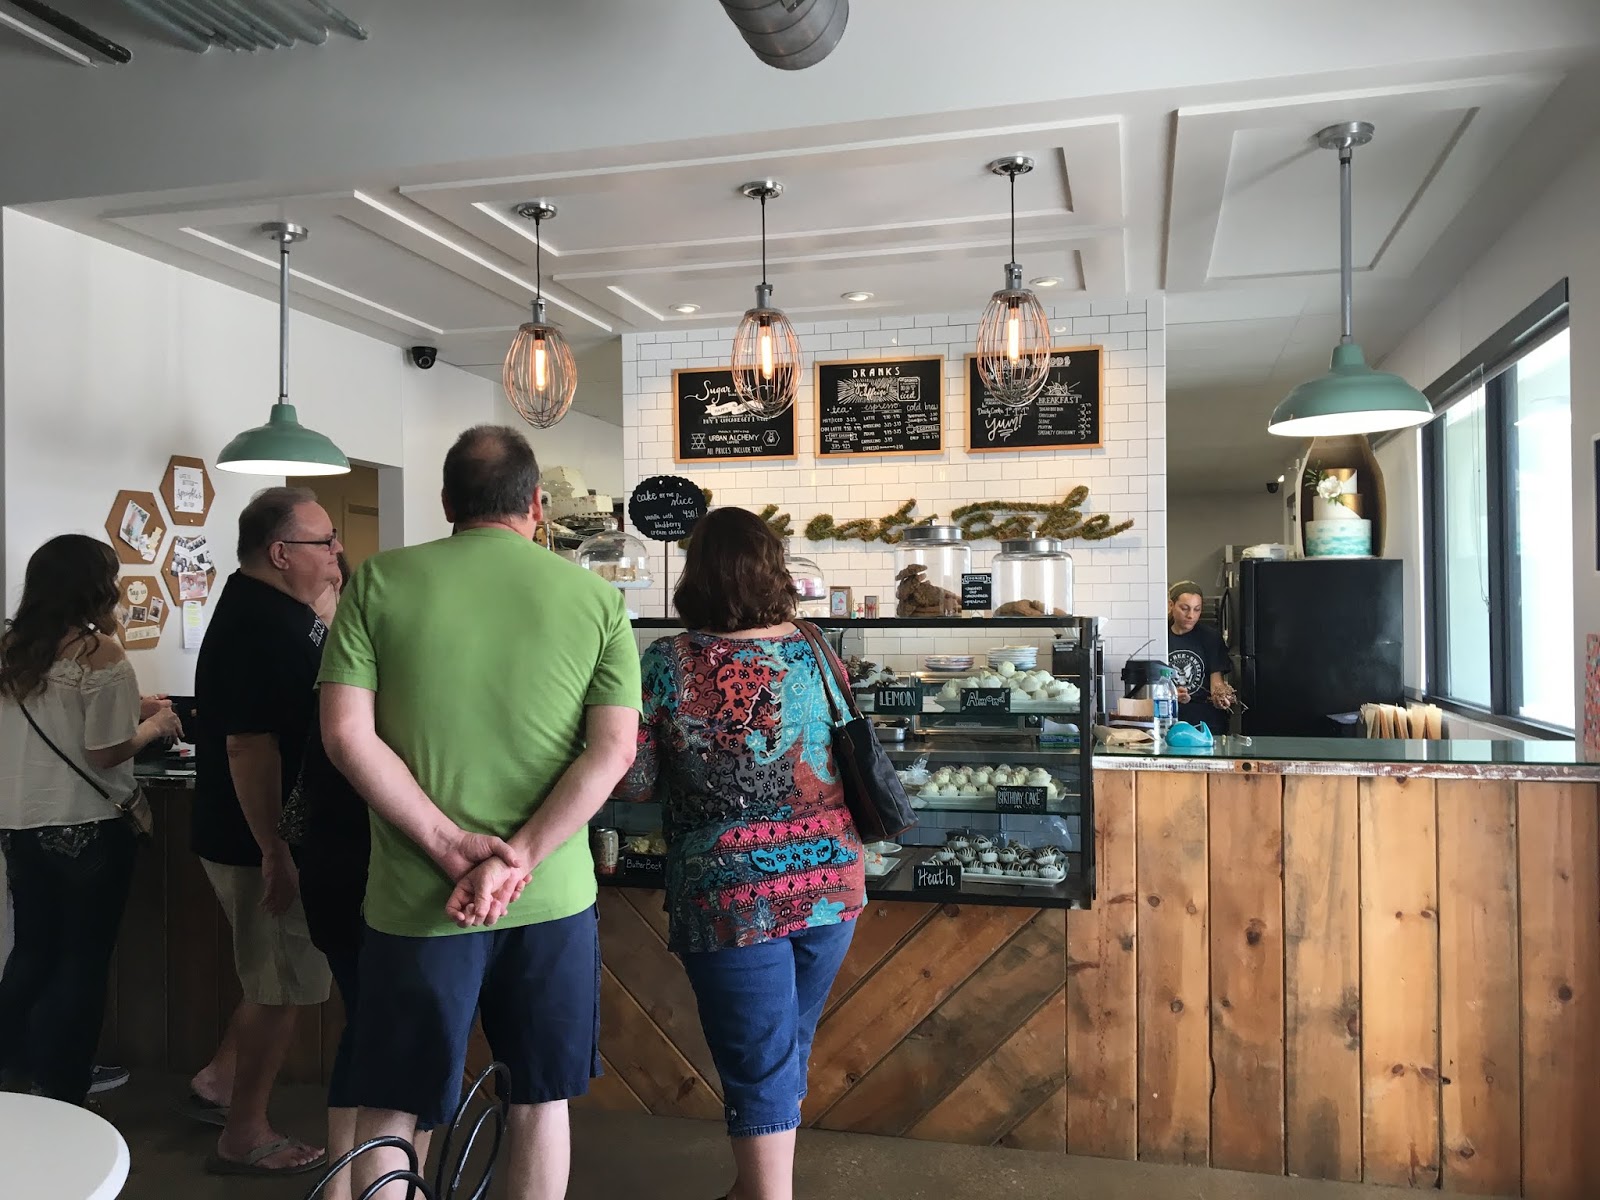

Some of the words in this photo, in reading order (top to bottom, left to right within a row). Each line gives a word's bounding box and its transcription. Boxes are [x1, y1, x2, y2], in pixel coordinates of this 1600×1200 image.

[852, 366, 900, 378] DRANKS
[906, 402, 922, 411] cold
[924, 402, 939, 410] brew
[1037, 396, 1080, 405] BREAKFAST
[830, 405, 850, 414] tea
[863, 402, 899, 414] espresso
[984, 414, 1023, 442] yum!
[729, 433, 760, 441] ALCHEMY
[670, 493, 694, 506] slice
[951, 485, 1134, 541] cake
[879, 690, 916, 707] LEMON
[966, 690, 1006, 707] Almond
[917, 867, 956, 887] Heath
